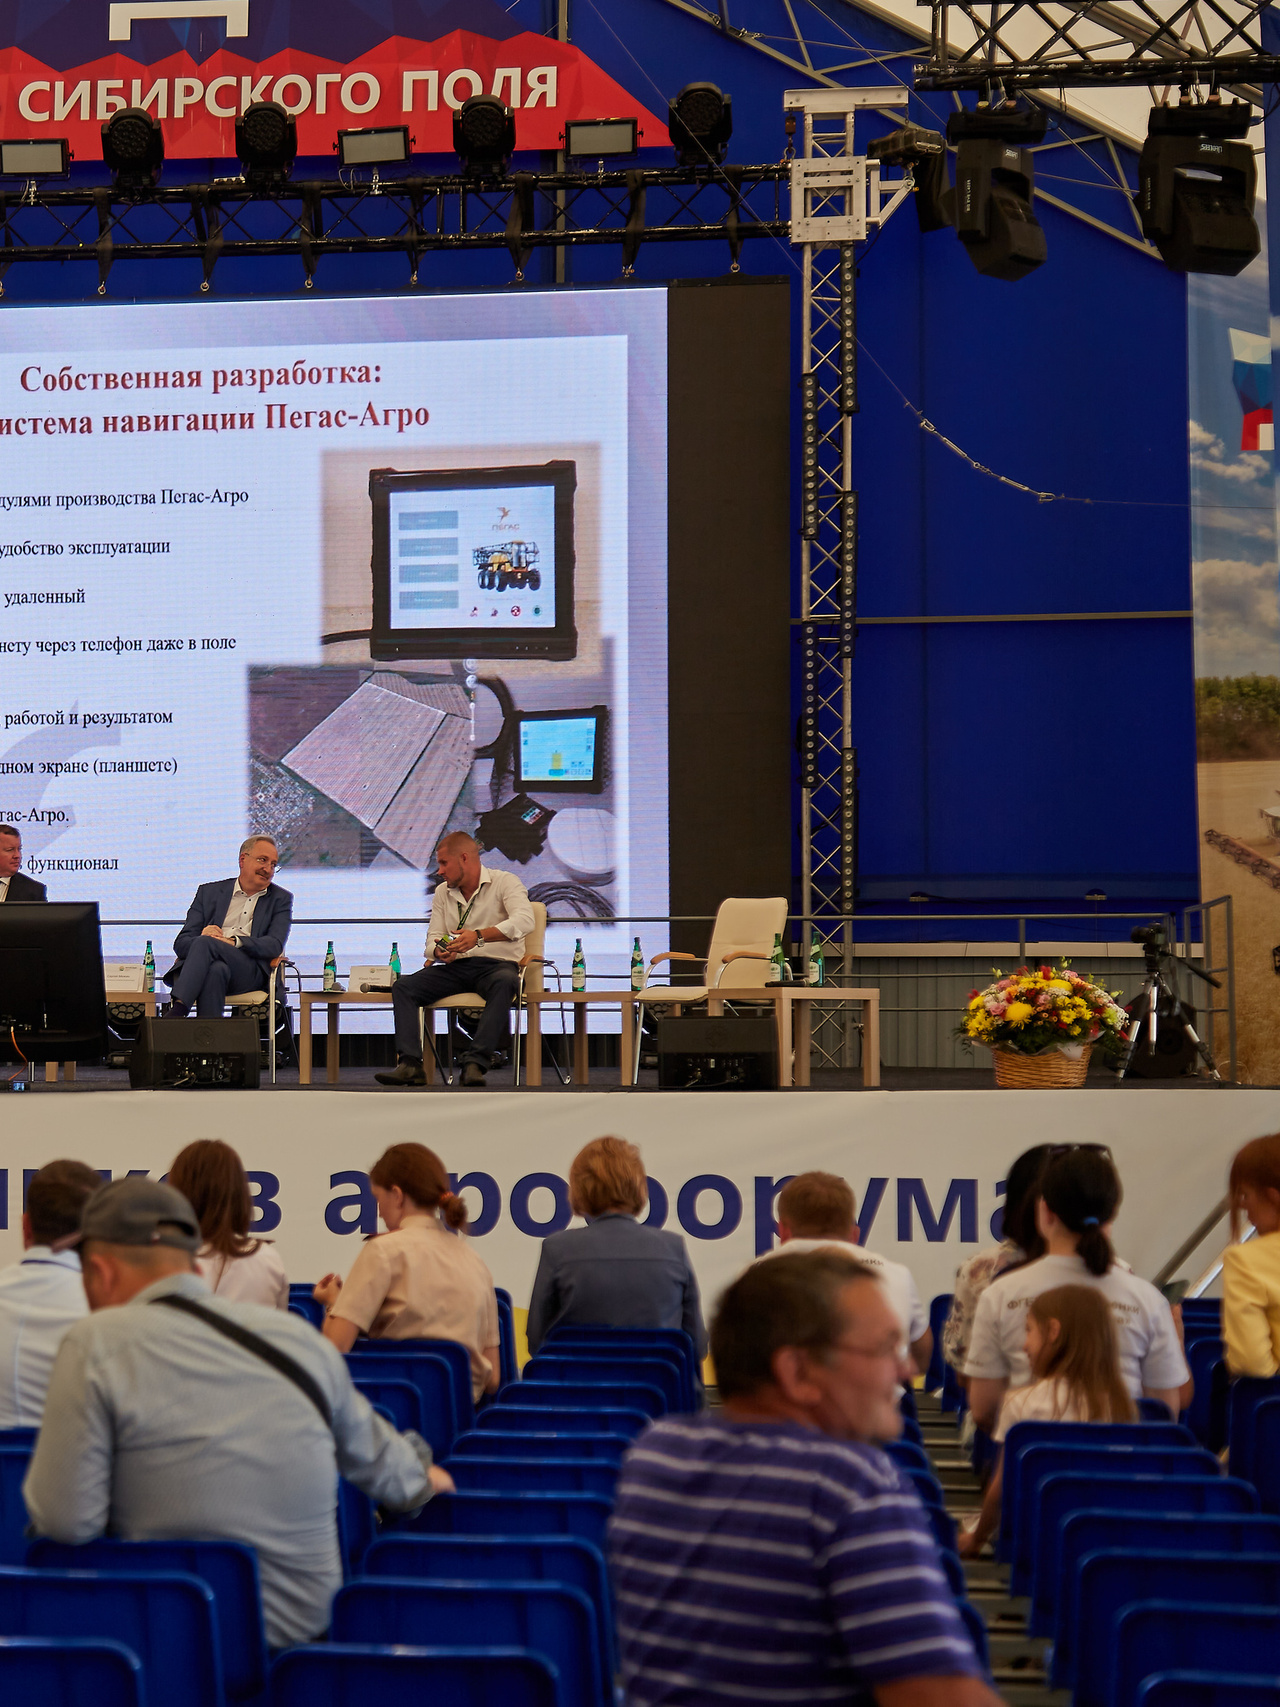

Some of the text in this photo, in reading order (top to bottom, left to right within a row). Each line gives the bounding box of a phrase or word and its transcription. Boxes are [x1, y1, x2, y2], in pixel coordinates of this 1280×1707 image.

[18, 71, 381, 122] СИБИРСКОГО
[402, 65, 558, 112] ПОЛЯ
[19, 359, 381, 395] Собственная разработка:
[102, 412, 255, 434] навигации
[264, 401, 430, 433] Пегас-Агро
[56, 493, 156, 511] производства
[161, 488, 249, 507] Пегас-Агро
[68, 541, 170, 558] эксплуатации
[3, 588, 86, 609] удаленный
[35, 640, 76, 657] через
[80, 635, 143, 656] телефон
[146, 639, 184, 653] даже
[188, 638, 197, 650] в
[201, 638, 237, 650] поле
[4, 709, 65, 730] работой
[68, 713, 79, 725] и
[82, 712, 173, 729] результатом
[38, 762, 89, 778] экране
[93, 758, 178, 775] (планшете)
[26, 854, 119, 873] функционал
